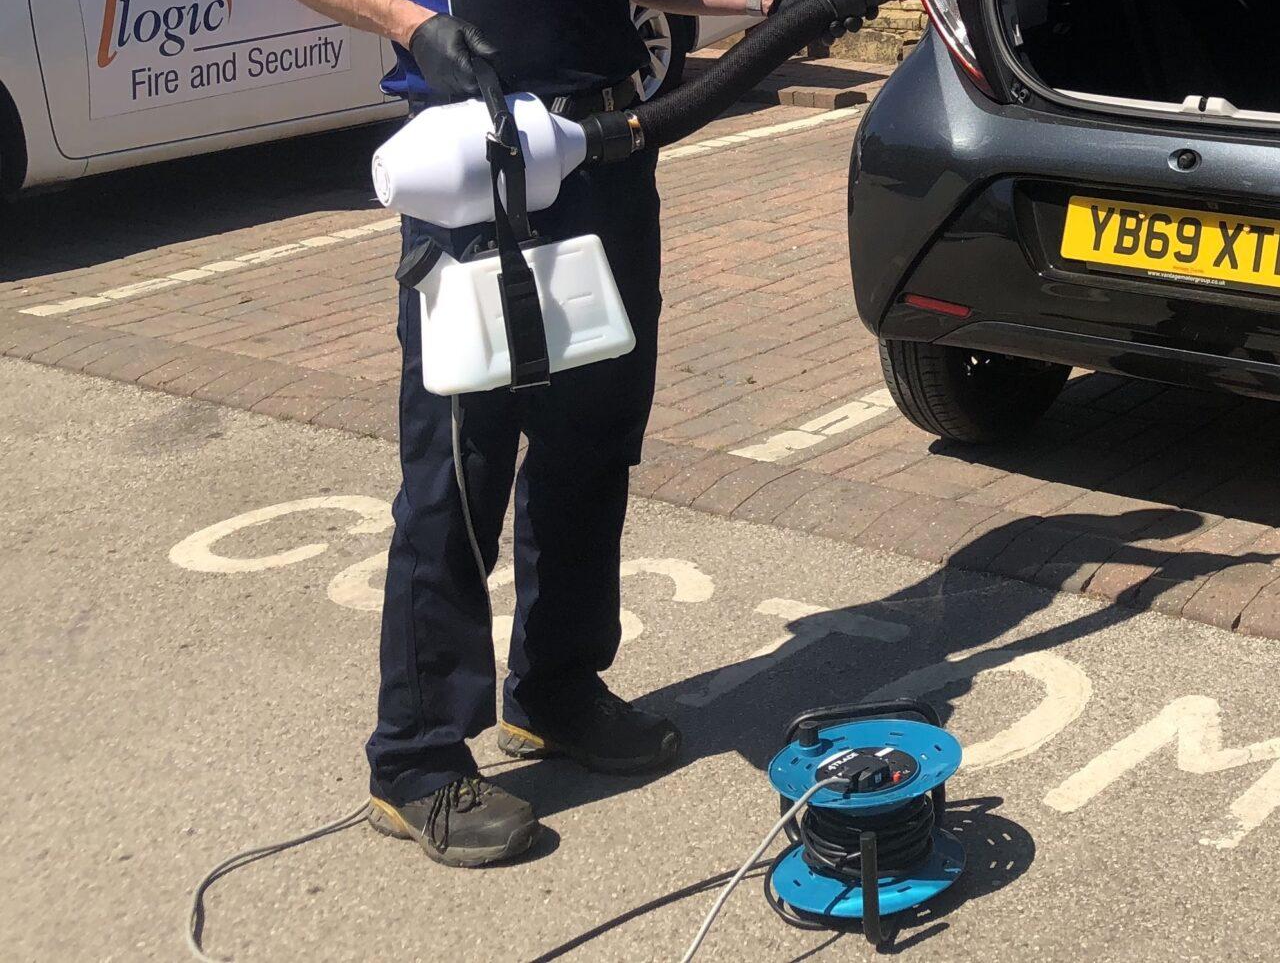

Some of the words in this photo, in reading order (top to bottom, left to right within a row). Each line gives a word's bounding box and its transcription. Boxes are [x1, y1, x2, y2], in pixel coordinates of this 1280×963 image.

[130, 66, 179, 100] Fire
[190, 52, 237, 89] and
[248, 36, 345, 78] Security
[1090, 204, 1202, 264] YB69
